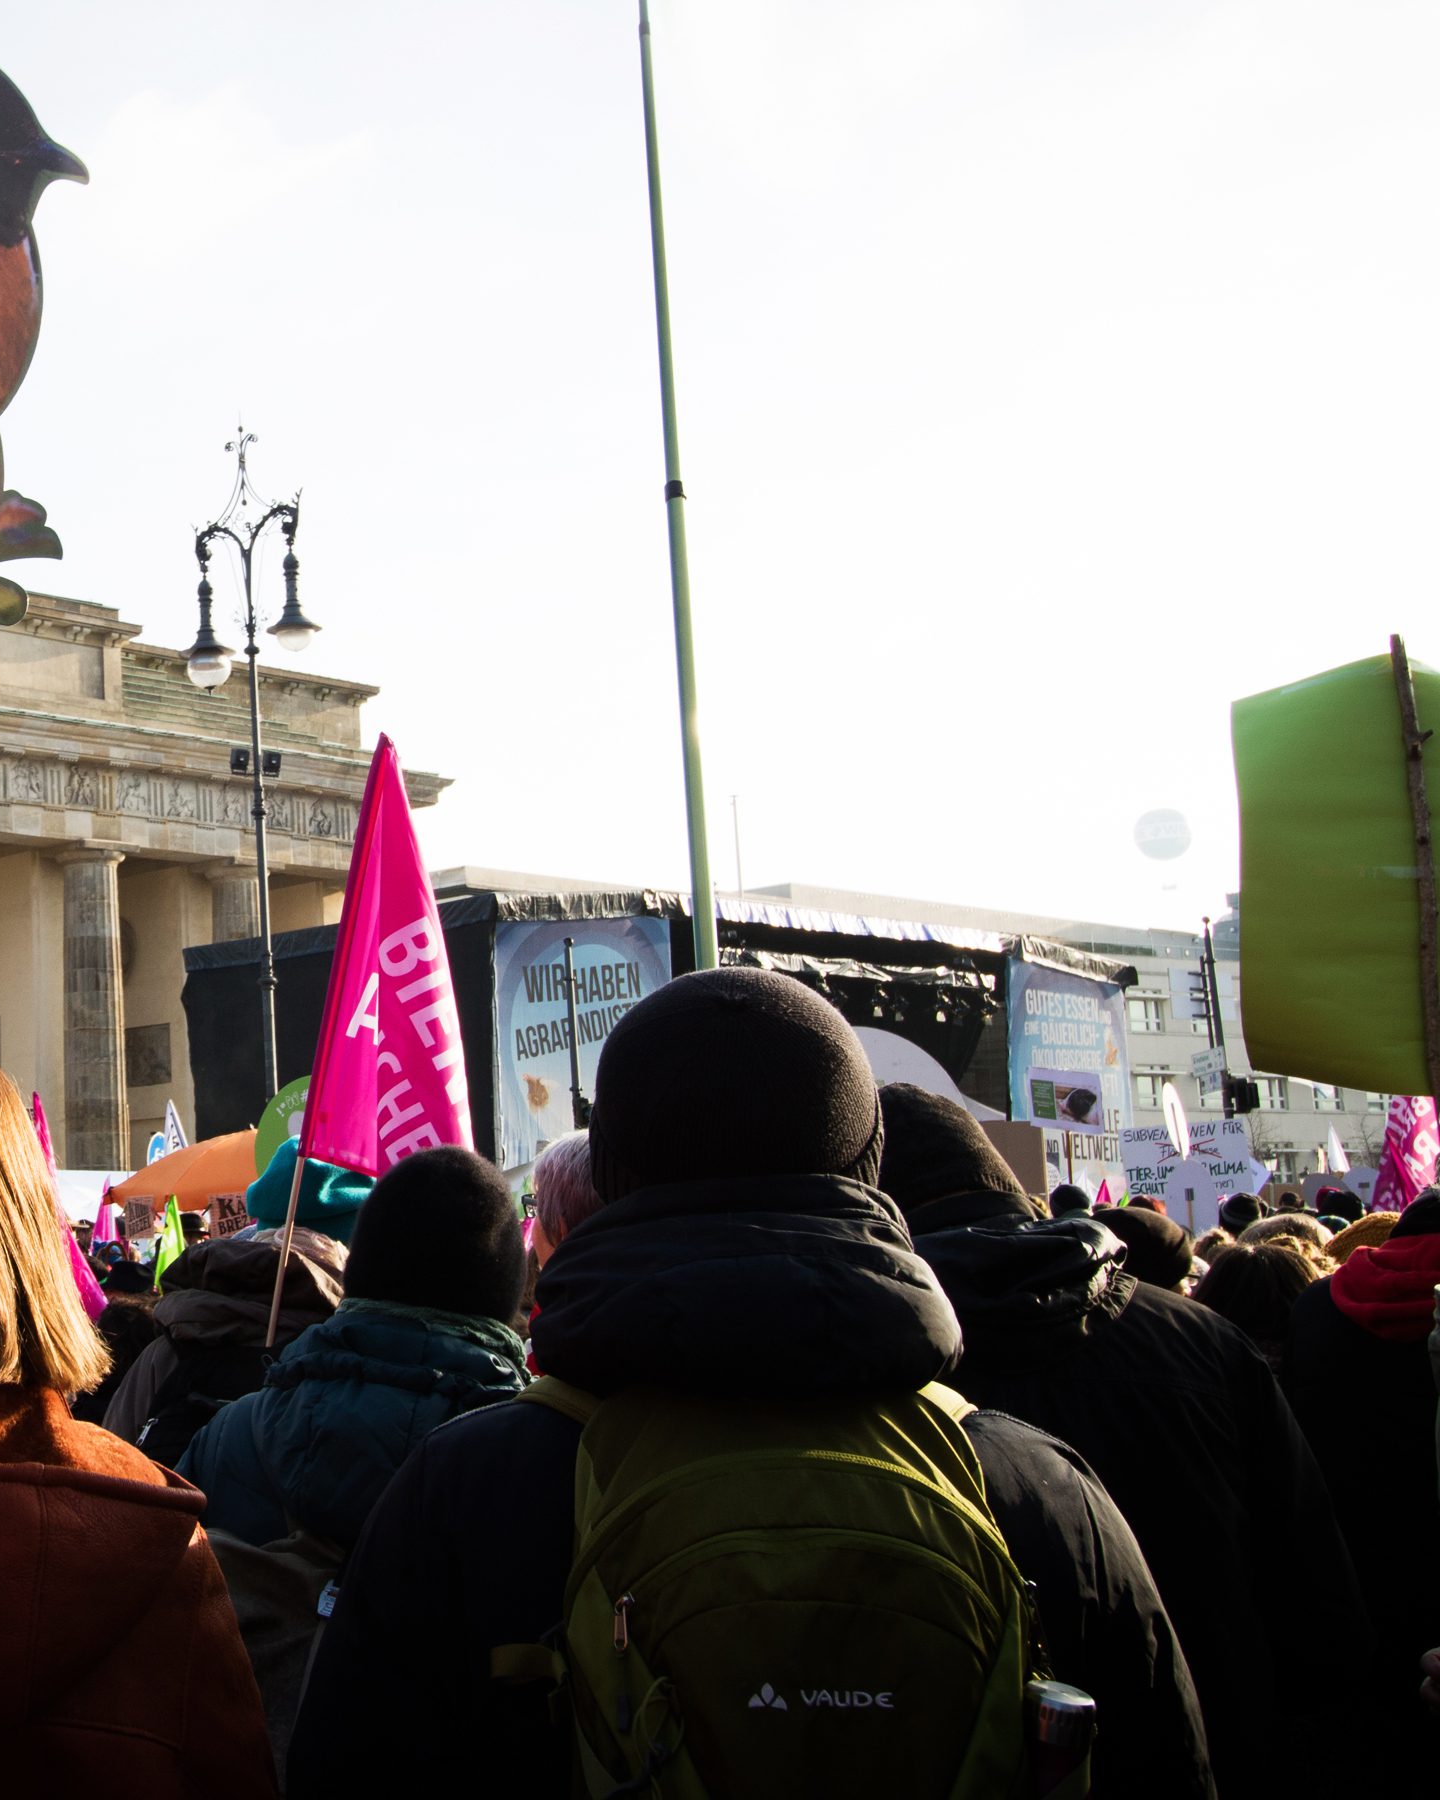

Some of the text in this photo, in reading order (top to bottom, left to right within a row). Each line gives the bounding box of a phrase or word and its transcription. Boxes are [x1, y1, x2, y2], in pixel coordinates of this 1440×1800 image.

[523, 962, 641, 1005] WIR HABEN
[1025, 988, 1063, 1018] GUTES
[1064, 993, 1099, 1023] ESSEN
[1041, 1018, 1100, 1047] BÄUERLICH-
[1222, 1121, 1244, 1136] FÜR
[216, 1194, 247, 1220] KÄ
[218, 1213, 248, 1235] BREZ
[800, 1689, 895, 1708] VAUDE
